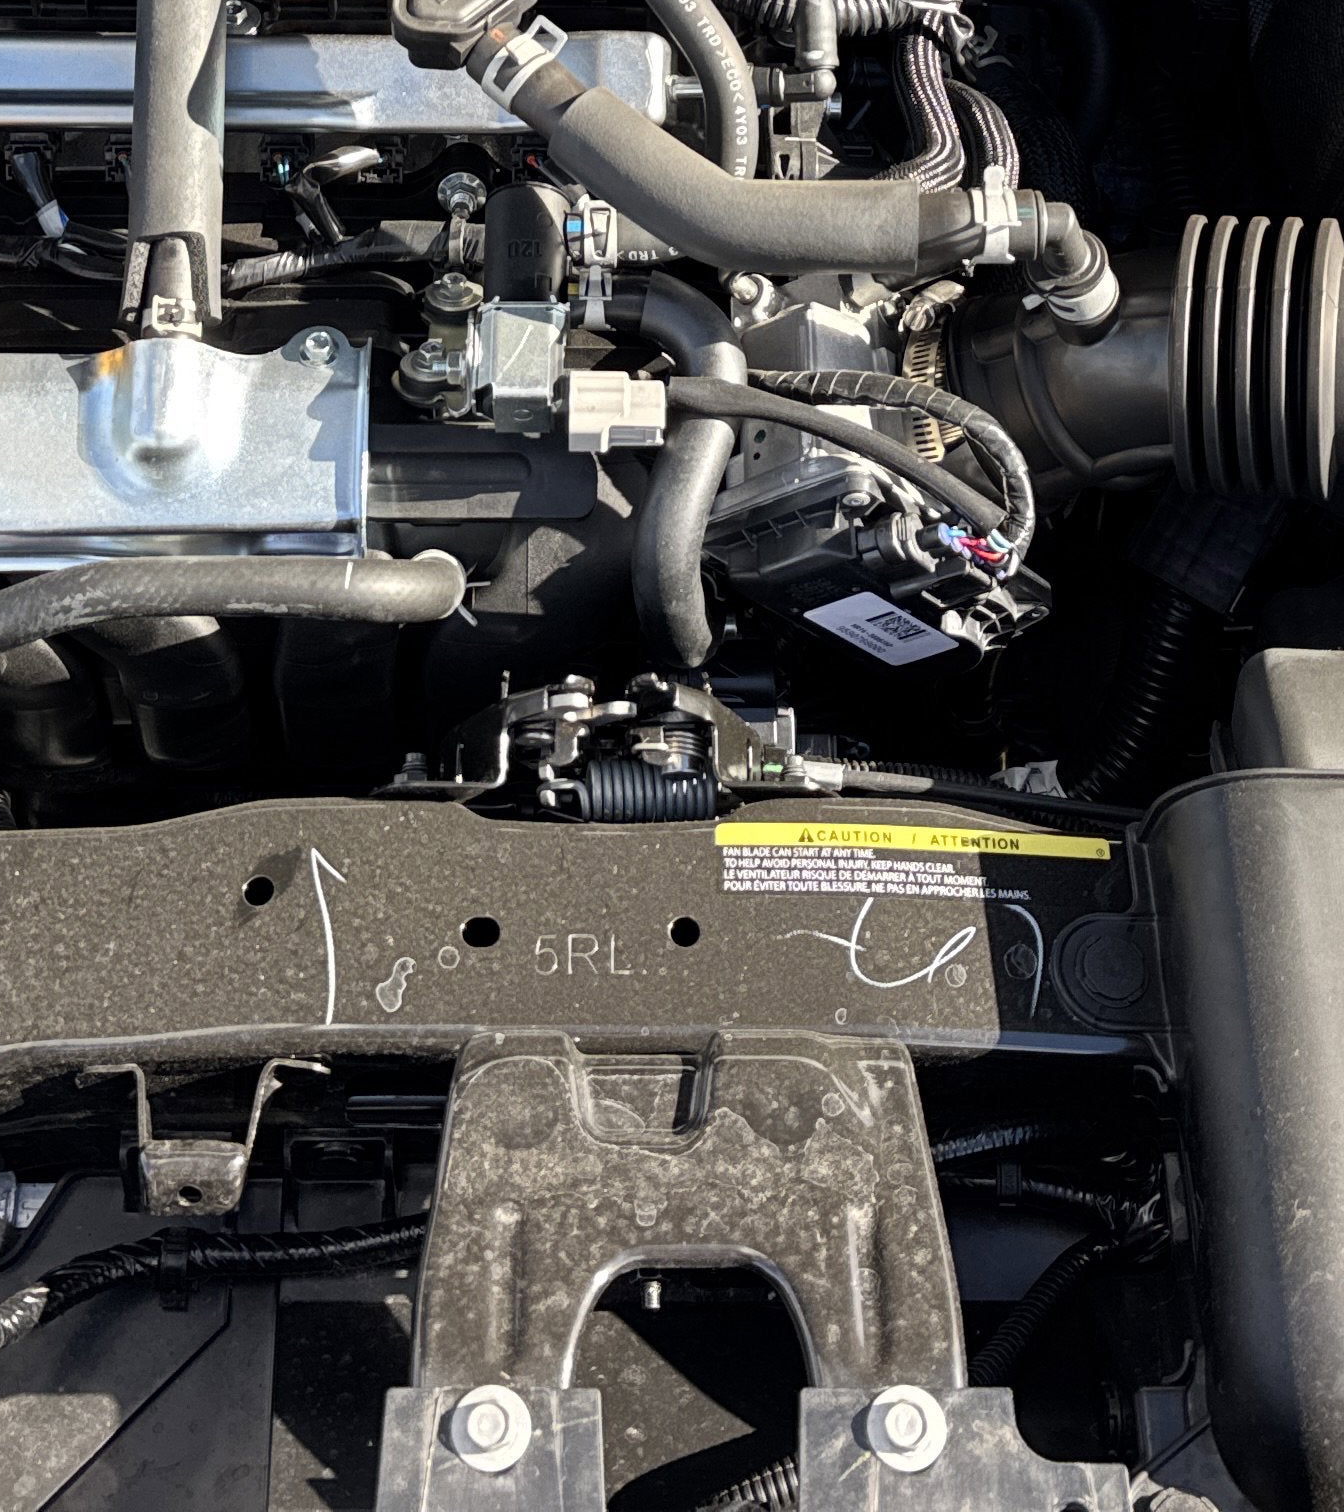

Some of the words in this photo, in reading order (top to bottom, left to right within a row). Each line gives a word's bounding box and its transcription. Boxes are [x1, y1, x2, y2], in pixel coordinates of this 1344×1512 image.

[816, 830, 892, 843] CAUTION
[930, 834, 1020, 851] ATTENTION
[723, 847, 742, 857] FAN
[742, 847, 771, 857] BLADE
[772, 848, 792, 857] CAN
[793, 848, 819, 858] START
[820, 848, 831, 858] AT
[833, 848, 852, 858] ANY
[724, 858, 737, 868] TO
[738, 858, 760, 868] HELP
[762, 858, 790, 868] AVOID
[791, 859, 837, 869] PERSONAL
[871, 860, 892, 870] KEEP
[893, 861, 925, 872] HANDS
[723, 869, 736, 879] LE
[736, 869, 800, 880] VENTILATEUR
[801, 870, 837, 880] RISQUE
[839, 871, 852, 881] DE
[854, 870, 906, 882] DÉMARRER
[917, 873, 943, 883] TOUT
[723, 880, 752, 891] POUR
[753, 879, 786, 891] ÉVITER
[787, 881, 820, 892] TOUTE
[872, 883, 886, 893] NE
[887, 883, 905, 894] PAS
[906, 884, 919, 894] EN
[921, 885, 979, 898] APPROCHER
[979, 887, 997, 898] LES
